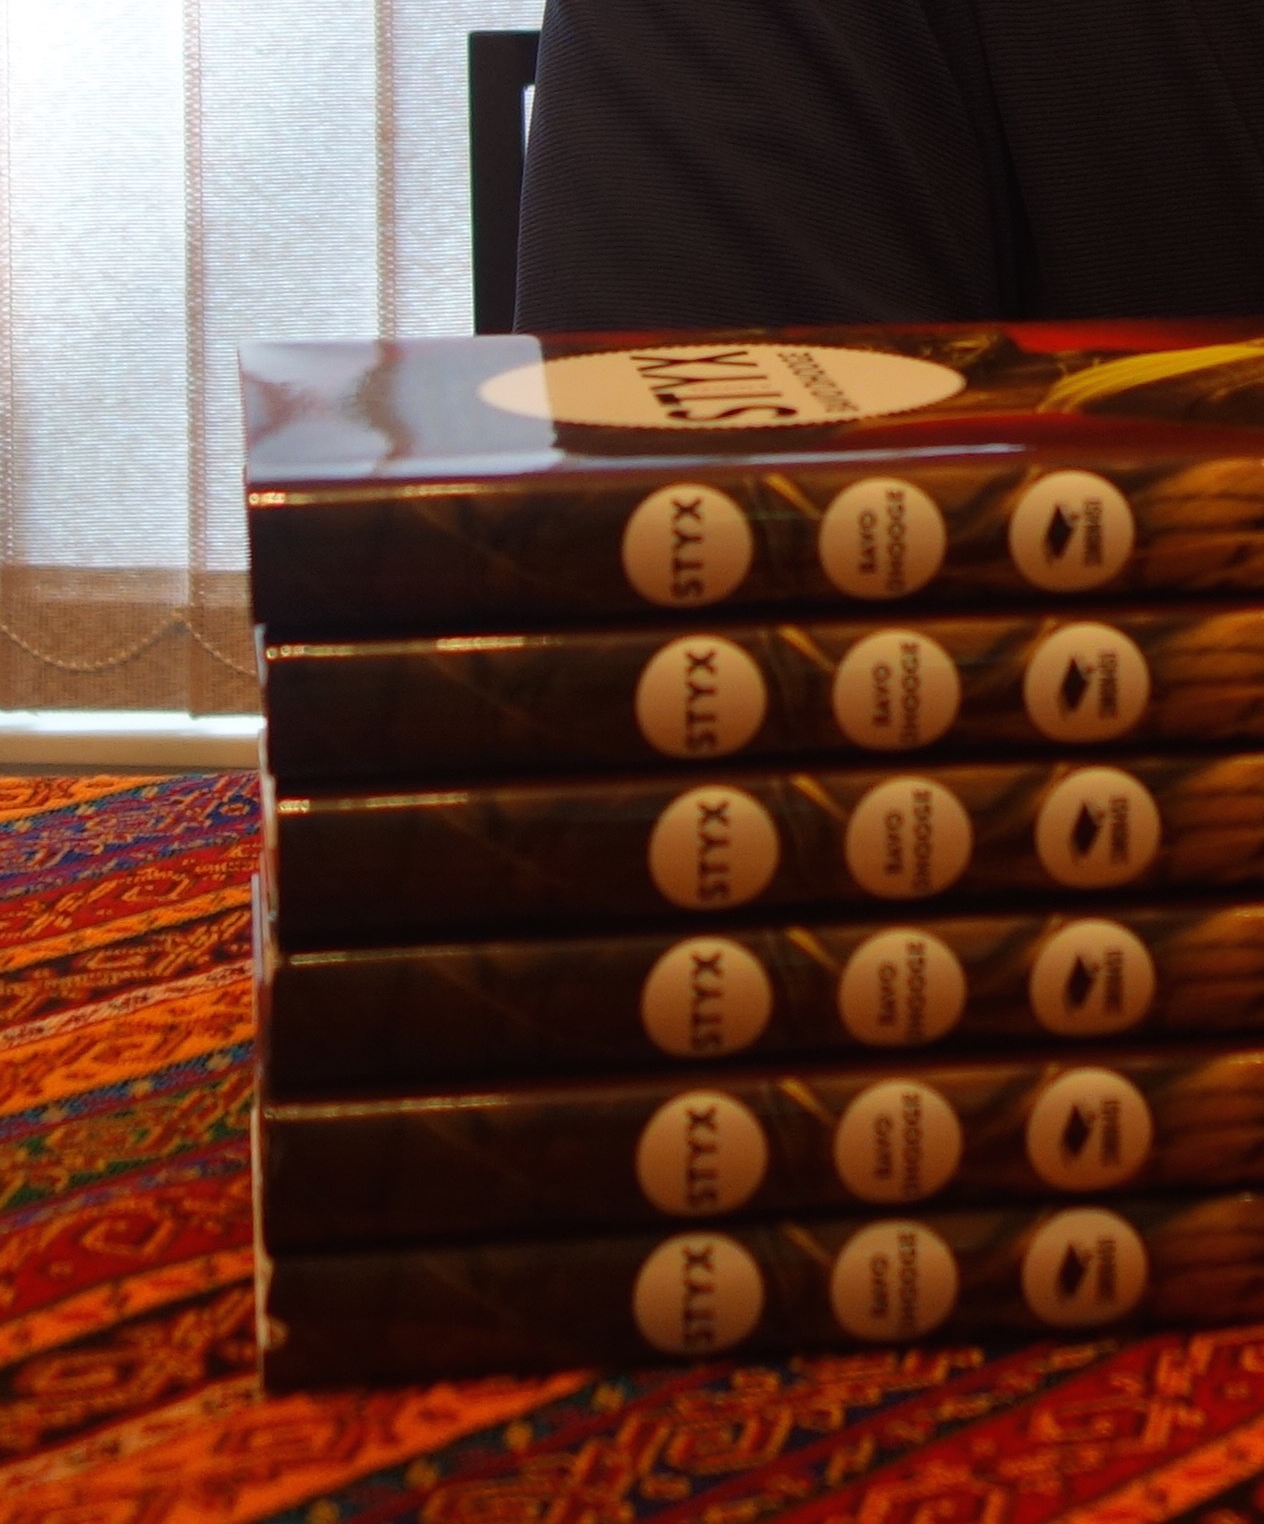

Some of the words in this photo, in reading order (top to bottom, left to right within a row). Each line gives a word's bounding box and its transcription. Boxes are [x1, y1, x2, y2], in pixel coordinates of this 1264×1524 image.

[630, 351, 798, 421] STYX
[671, 497, 706, 599] STYX
[858, 511, 878, 575] BAVO
[885, 490, 907, 593] DHOOGE
[685, 650, 718, 750] STYX
[872, 663, 892, 728] BAVO
[900, 642, 921, 746] DHOOGE
[697, 800, 730, 901] STYX
[885, 812, 904, 876] BAVO
[912, 790, 933, 892] DHOOGE
[691, 951, 722, 1052] STYX
[684, 1107, 717, 1209] STYX
[681, 1246, 715, 1345] STYX
